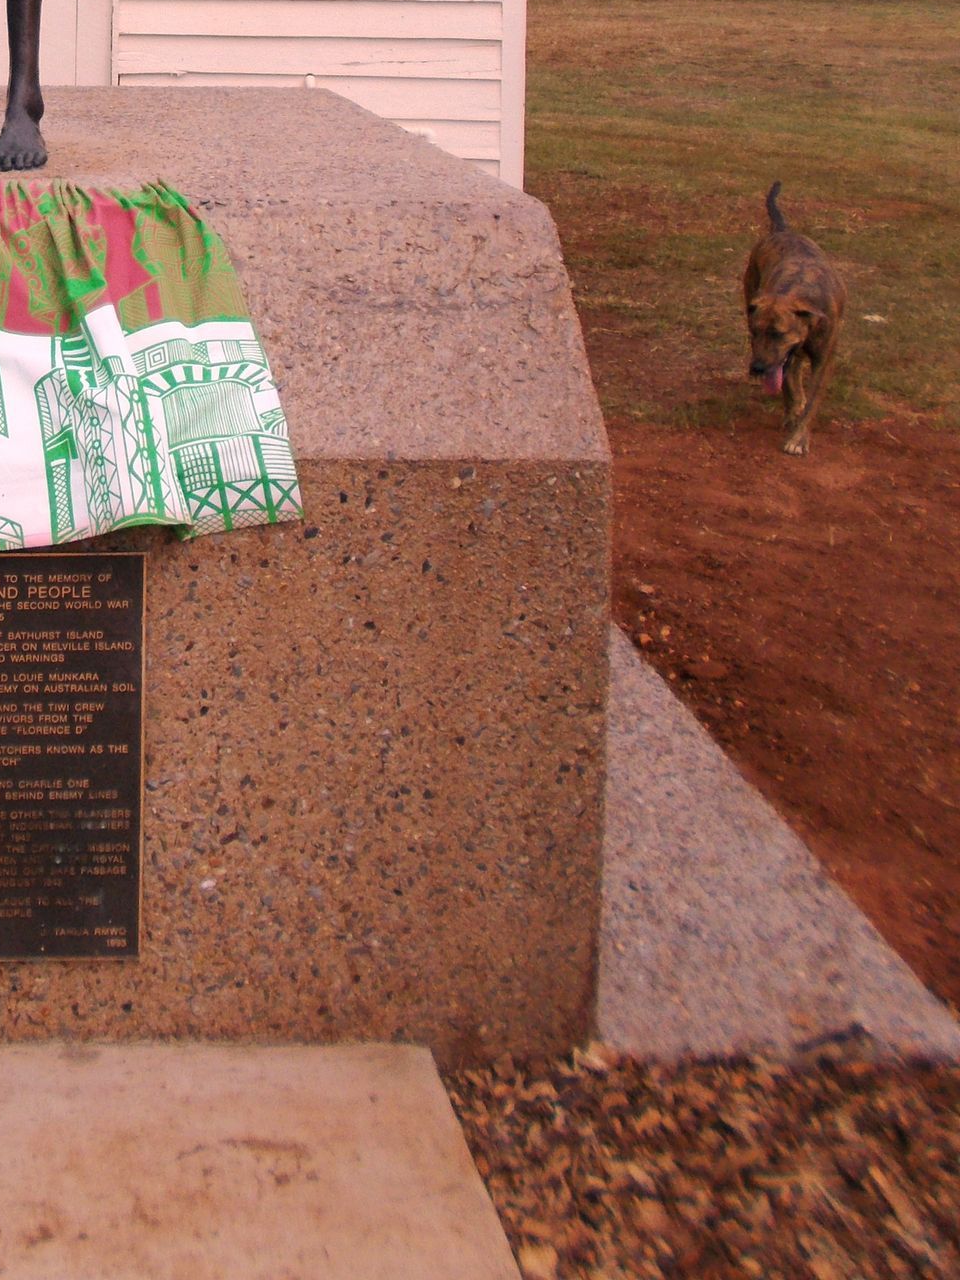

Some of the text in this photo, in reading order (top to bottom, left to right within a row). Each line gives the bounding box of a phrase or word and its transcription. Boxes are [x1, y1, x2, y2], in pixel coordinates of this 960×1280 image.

[4, 574, 18, 584] TO
[23, 574, 43, 584] THE
[48, 574, 94, 583] MEMORY
[98, 574, 112, 583] OF
[28, 587, 92, 599] PEOPLE
[17, 601, 60, 610] SECOND
[65, 600, 102, 610] WORLD
[107, 600, 129, 609] WAR
[7, 631, 61, 640] BATHURST
[66, 631, 104, 640] ISLAND
[22, 642, 38, 652] ON
[43, 642, 89, 652] MELVILLE
[10, 654, 65, 663] WARNINGS
[13, 673, 43, 682] LOUIE
[48, 673, 99, 681] MUNKARA
[23, 684, 39, 693] ON
[44, 684, 108, 693] AUSTRALIAN
[113, 684, 136, 692] SOIL
[23, 703, 43, 713] THE
[48, 703, 70, 712] TIWI
[75, 703, 105, 712] CREW
[38, 714, 68, 723] FROM
[73, 714, 93, 723] THE
[46, 746, 85, 755] KNOWN
[89, 746, 104, 755] AS
[109, 745, 129, 754] THE
[18, 780, 63, 789] CHARLIE
[67, 780, 90, 789] ONE
[5, 791, 44, 801] BEHIND
[49, 791, 83, 800] ENEMY
